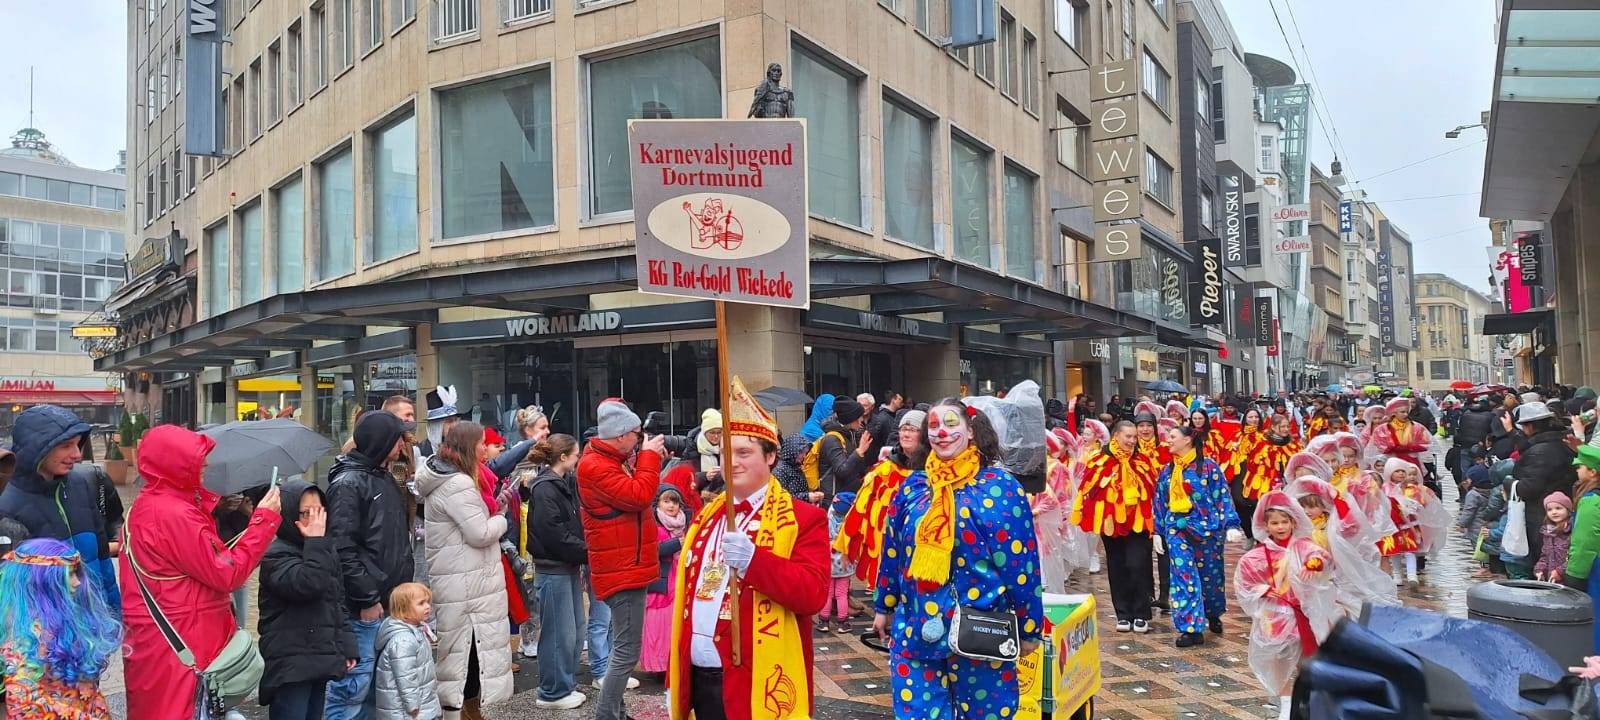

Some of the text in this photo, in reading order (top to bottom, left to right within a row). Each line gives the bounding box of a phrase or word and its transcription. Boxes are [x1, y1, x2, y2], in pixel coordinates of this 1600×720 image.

[639, 143, 793, 171] Karnevalsjugend
[1097, 66, 1133, 256] tewes
[662, 167, 763, 188] Dortmund
[1226, 191, 1241, 262] SWAROVSKI
[1341, 206, 1350, 229] KKH
[648, 260, 793, 299] KG Rot-Gold Wickede
[1521, 244, 1538, 281] snipes
[1200, 245, 1222, 318] Pieper
[506, 311, 621, 337] WORMLAND
